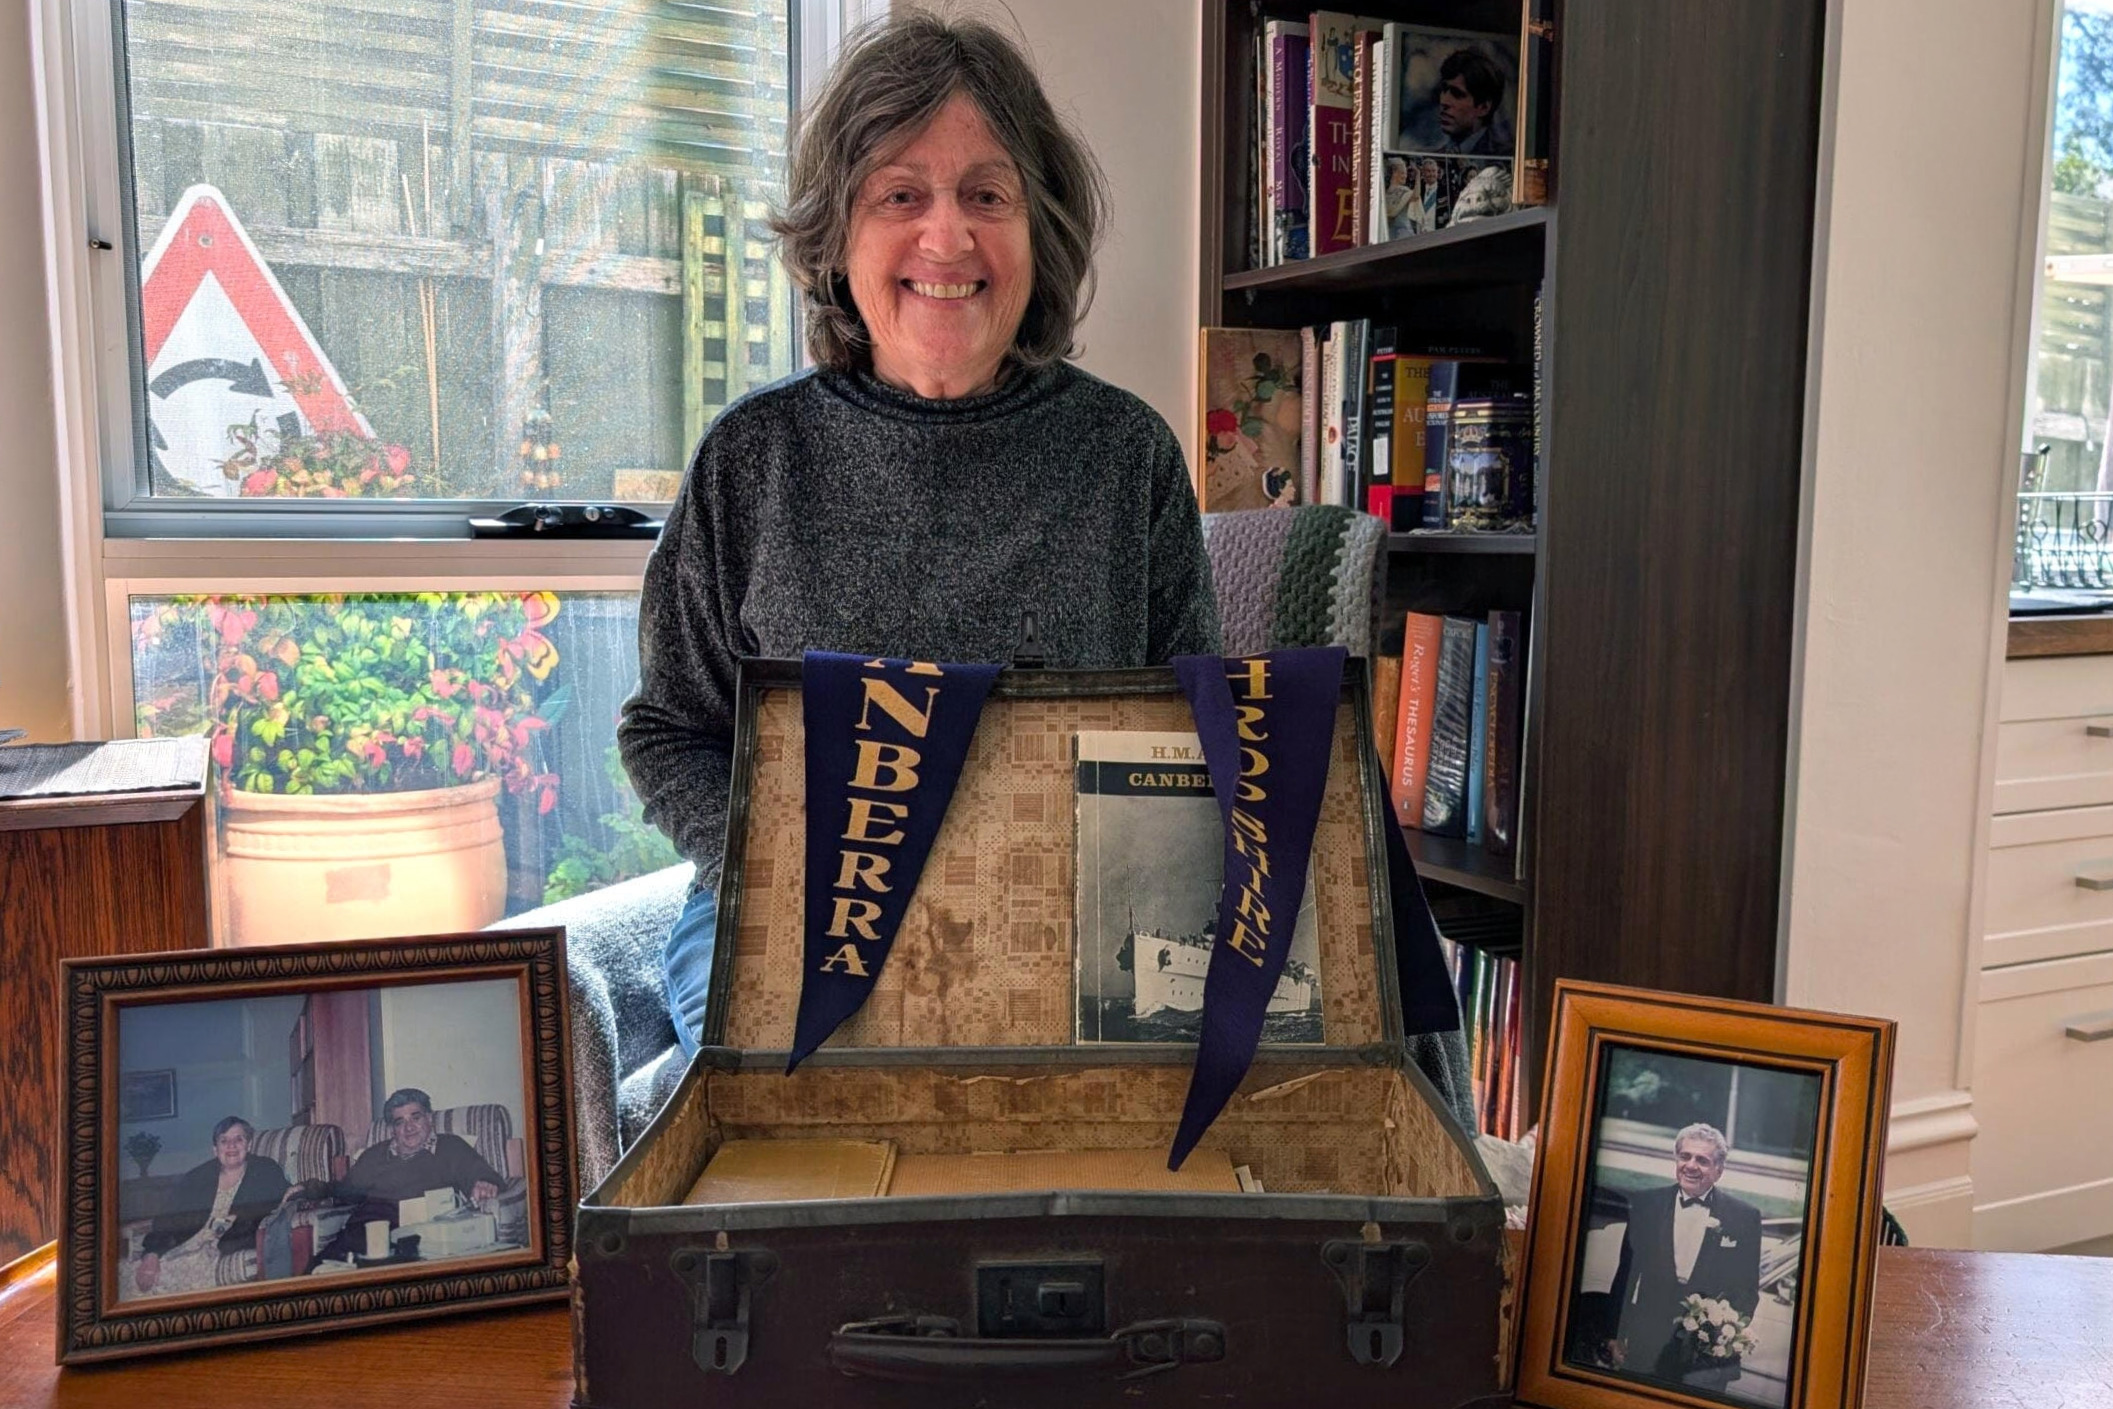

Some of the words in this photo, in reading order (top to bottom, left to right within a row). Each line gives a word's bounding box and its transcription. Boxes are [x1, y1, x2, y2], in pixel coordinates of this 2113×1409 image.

[1275, 180, 1284, 206] MAR
[1533, 297, 1542, 361] CROWNED
[1403, 406, 1426, 423] AU
[1347, 416, 1359, 472] PALACE
[1410, 642, 1426, 693] Roget's
[1402, 698, 1420, 787] THESAURUS
[1128, 773, 1214, 788] CANBE
